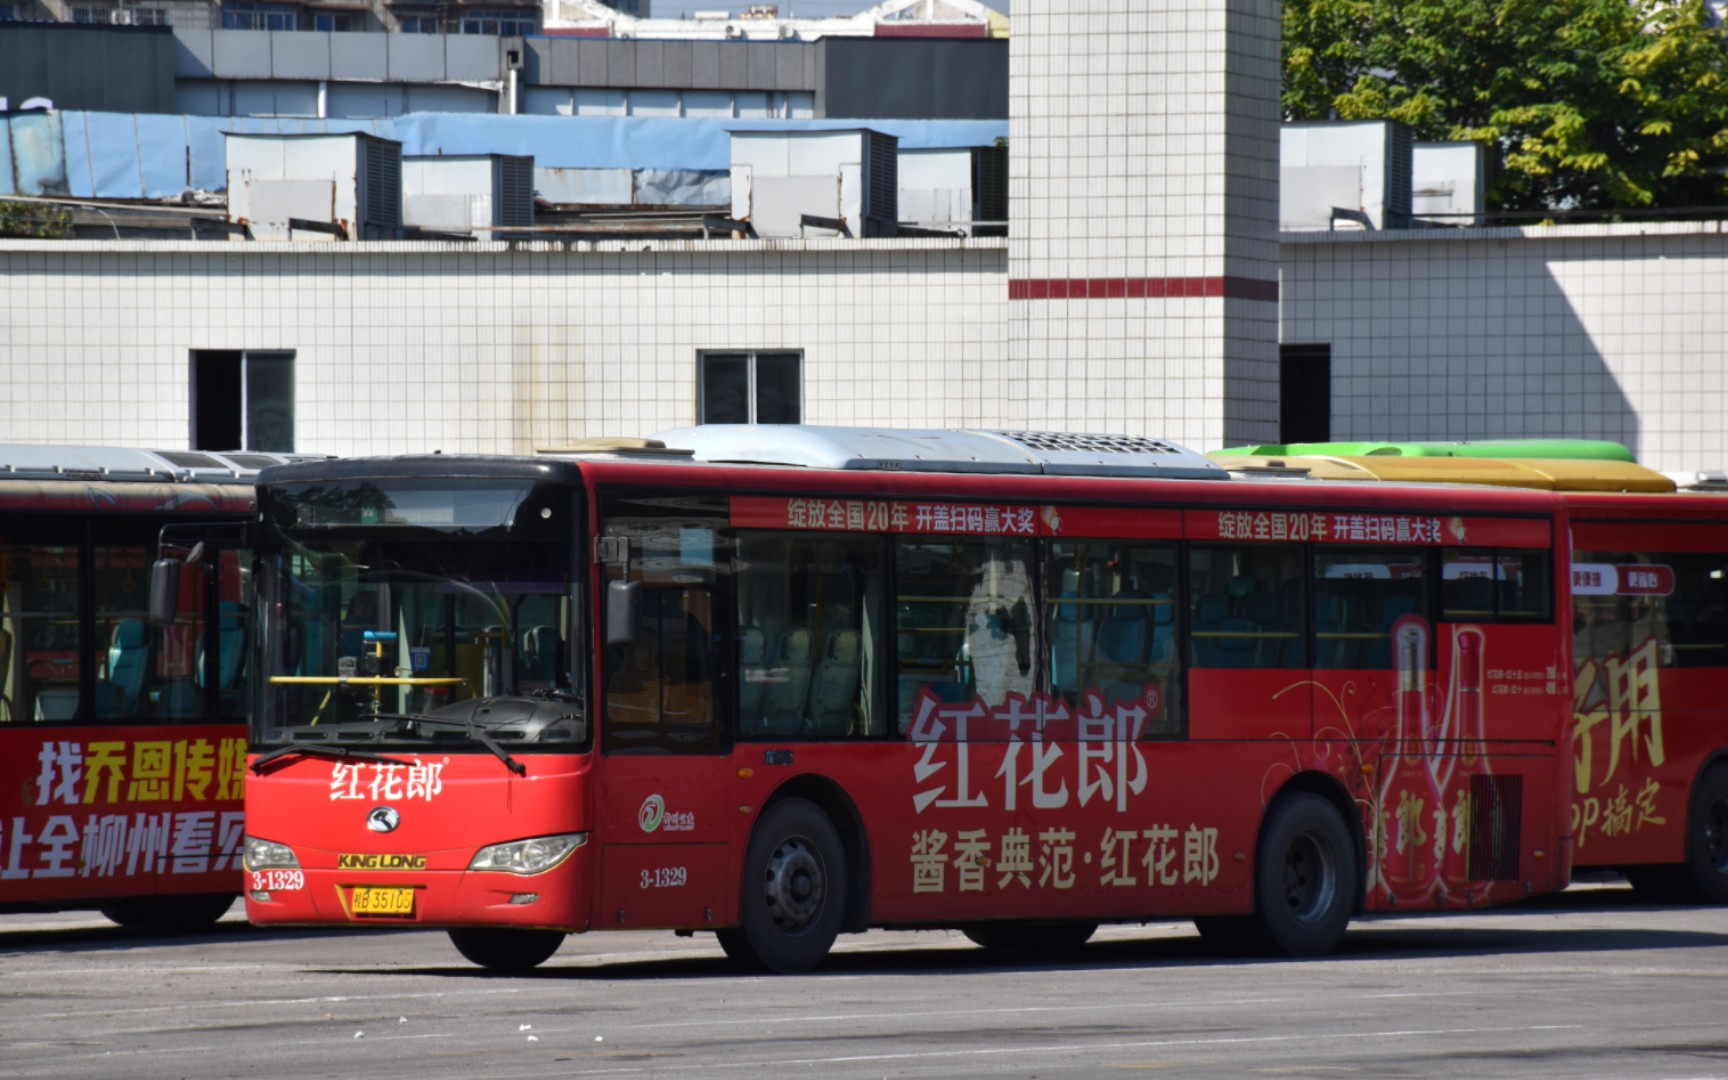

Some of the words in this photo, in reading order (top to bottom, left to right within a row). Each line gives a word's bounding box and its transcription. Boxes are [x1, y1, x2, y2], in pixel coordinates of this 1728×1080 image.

[787, 498, 909, 532] 绽放全国20年
[916, 506, 1034, 534] 开盖扫码赢大奖
[1218, 512, 1328, 541] 绽放全国20年
[910, 694, 1148, 814] 红花郎
[329, 758, 444, 802] 红花郎
[252, 870, 305, 890] 3-1329
[640, 866, 688, 889] 3-1329
